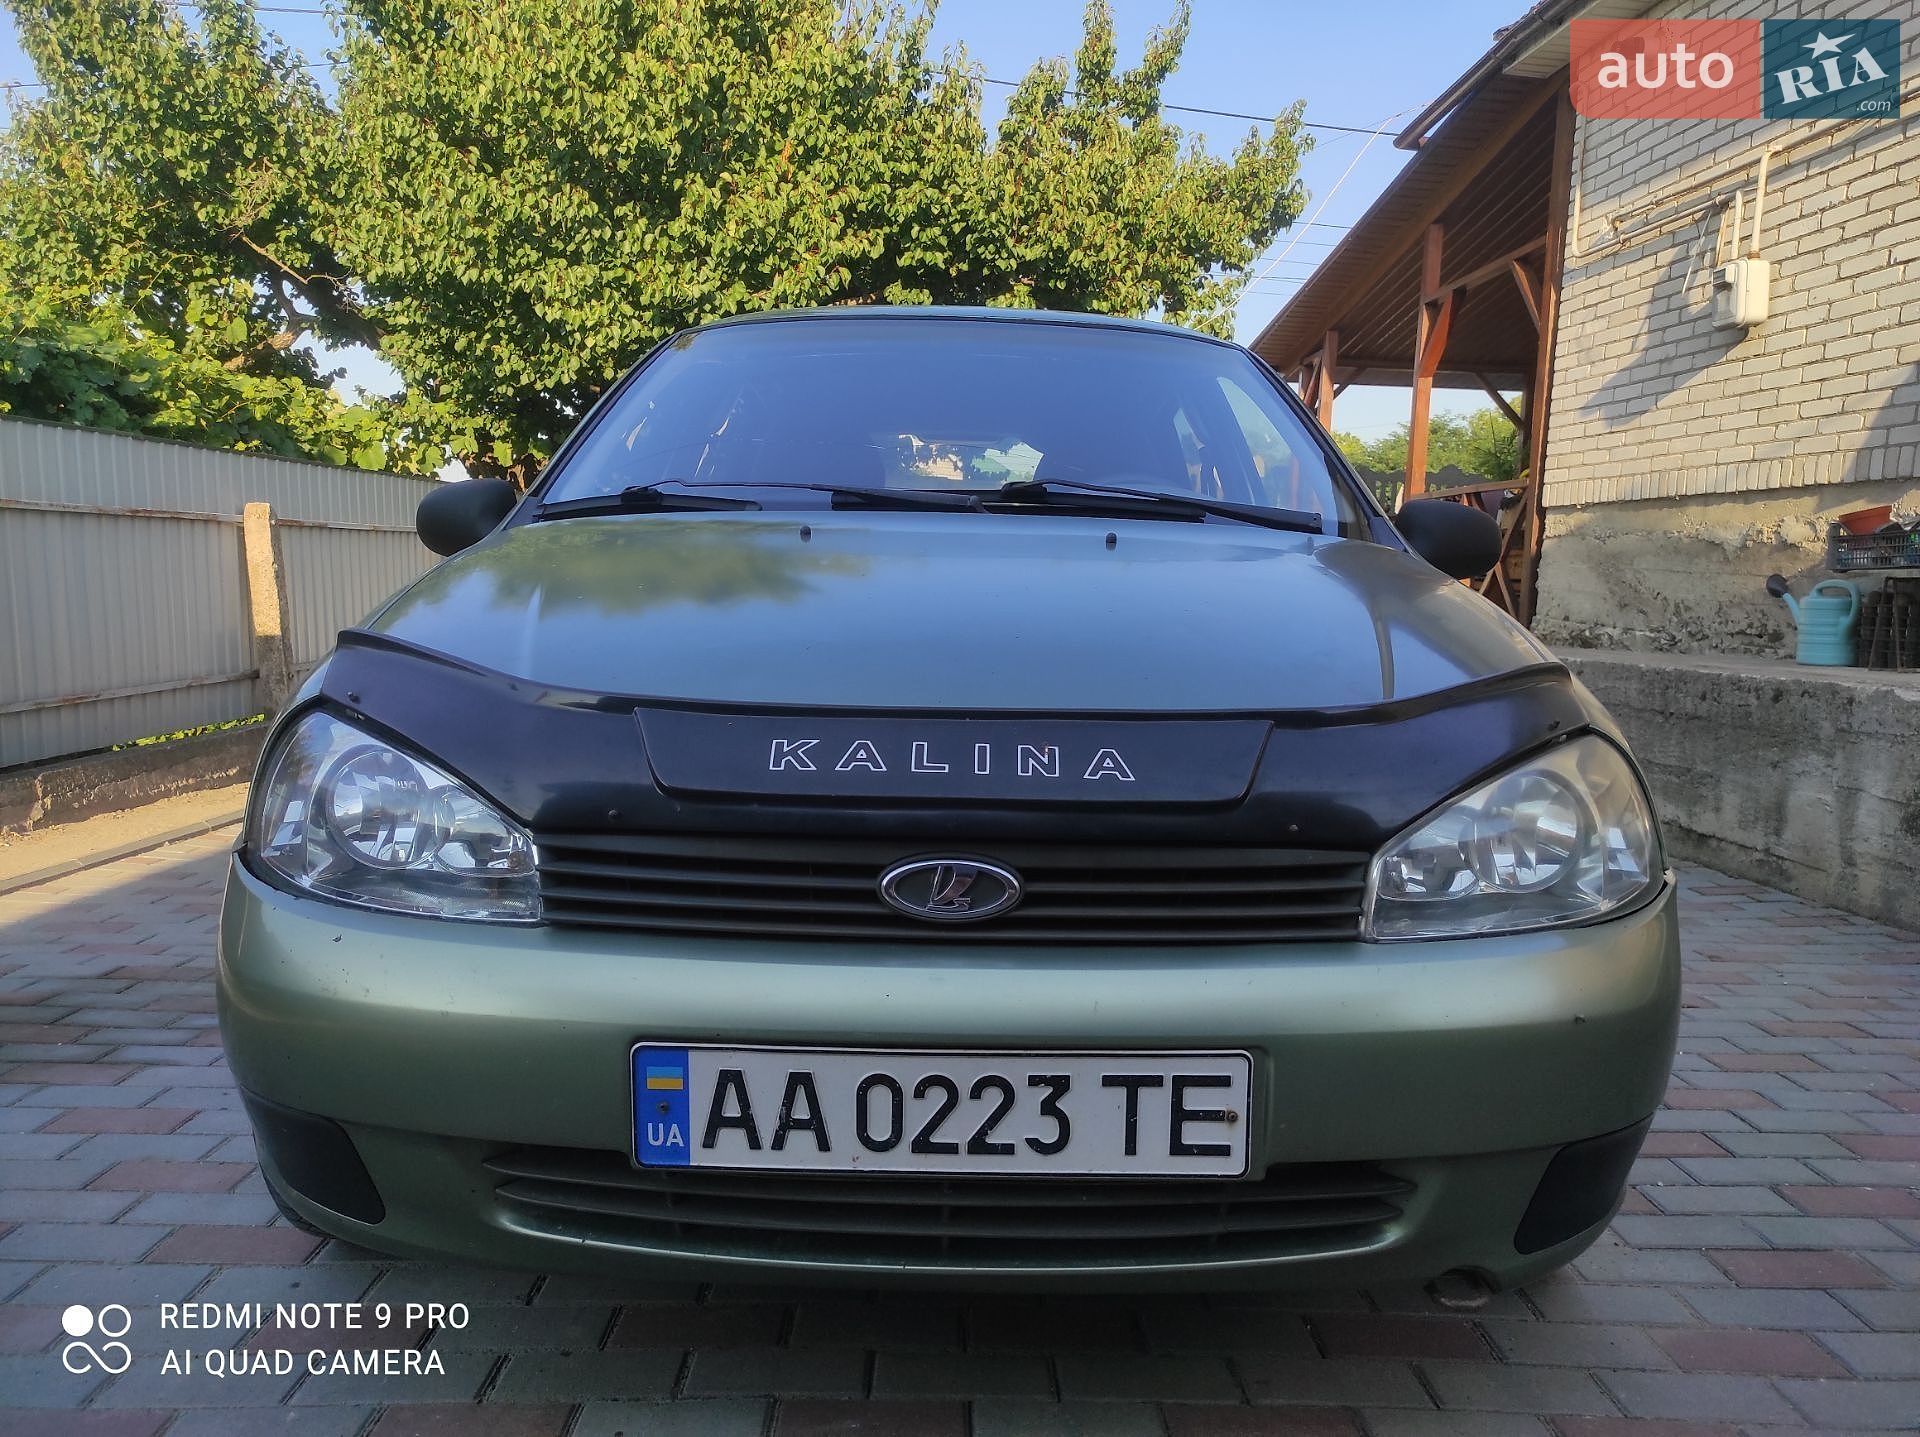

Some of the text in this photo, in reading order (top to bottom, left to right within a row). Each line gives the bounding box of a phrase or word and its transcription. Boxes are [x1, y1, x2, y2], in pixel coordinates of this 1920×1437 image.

[768, 739, 1135, 781] KALINA
[701, 1067, 1232, 1157] AA 0223 TE
[646, 1122, 684, 1147] UA
